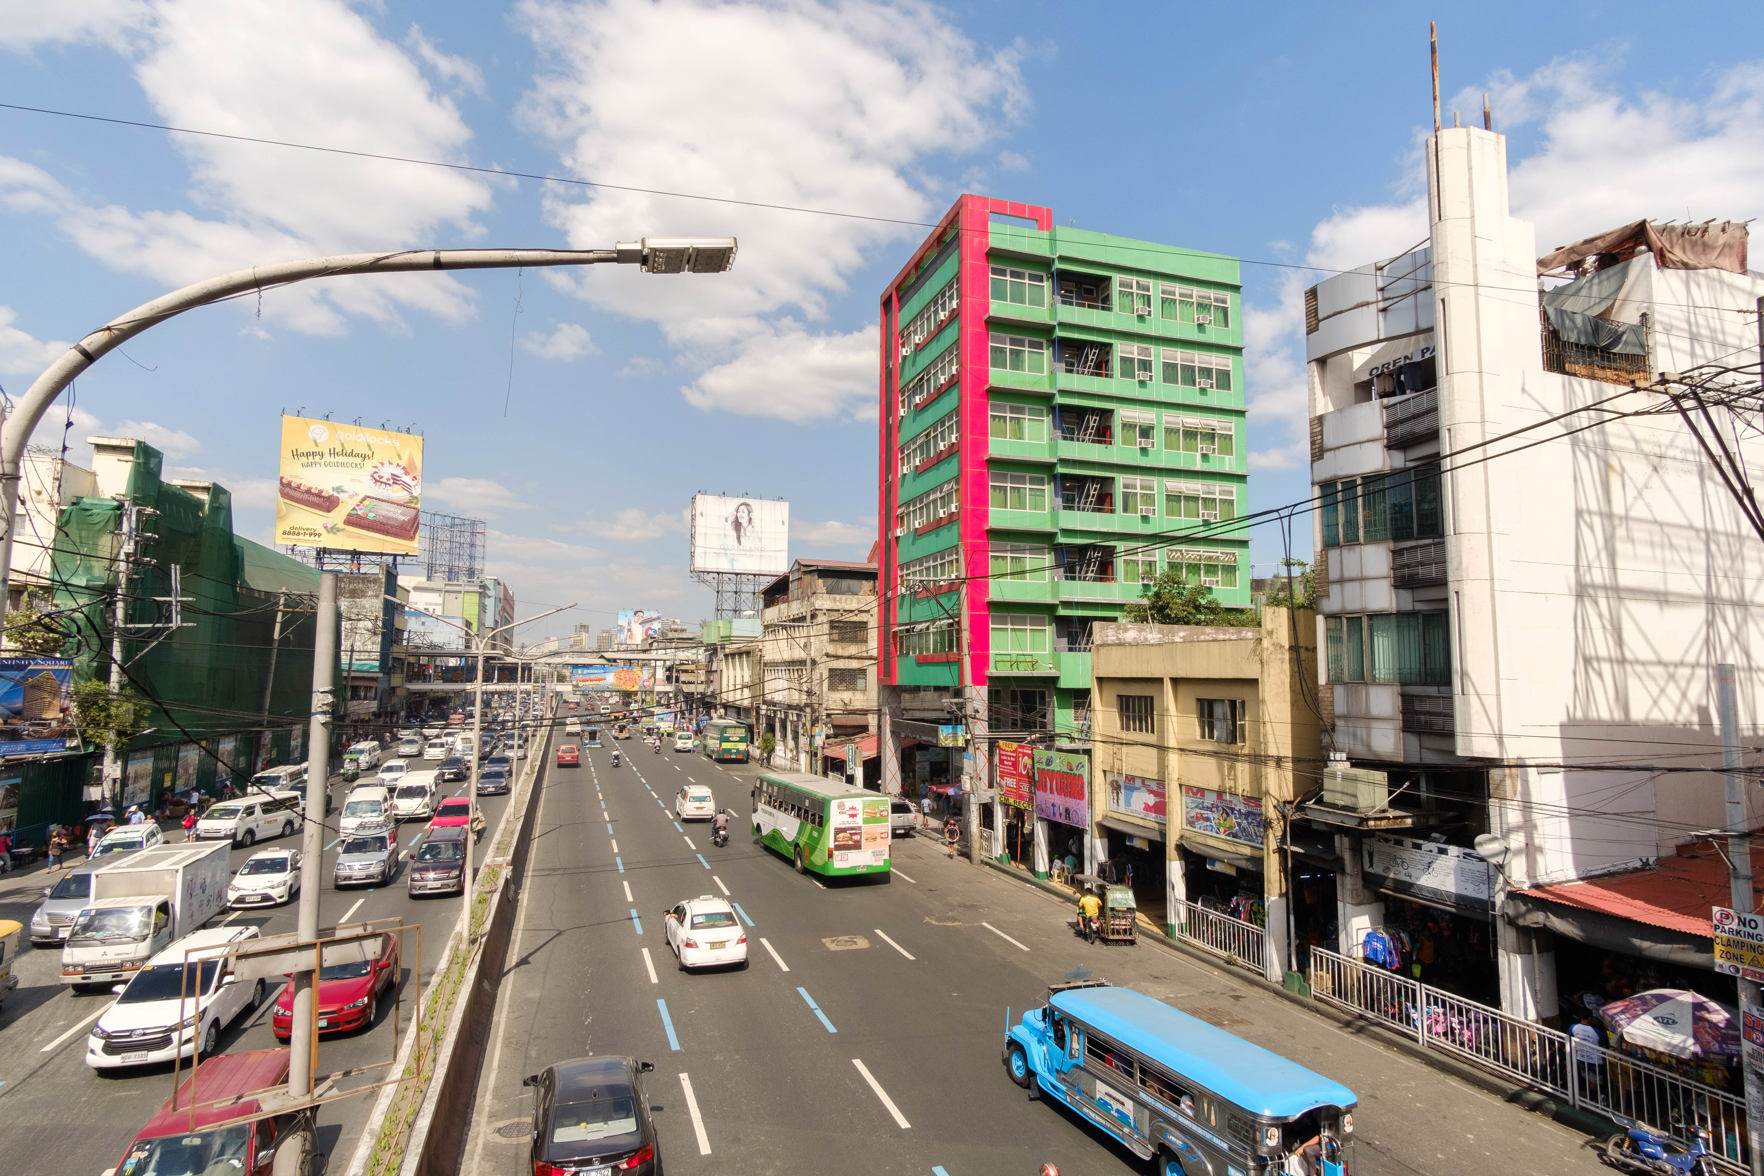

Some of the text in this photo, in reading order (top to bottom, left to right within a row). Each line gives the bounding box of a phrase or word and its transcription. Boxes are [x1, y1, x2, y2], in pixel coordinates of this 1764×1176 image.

[336, 431, 399, 447] goldilocks
[291, 447, 375, 462] Happy Holidays!
[301, 460, 365, 469] HAPPY GOLDILOCKS!
[289, 525, 317, 533] delivery
[1737, 916, 1758, 930] NO
[1714, 924, 1763, 942] PARKING
[1714, 936, 1764, 955] CLAMPING
[1719, 949, 1745, 964] ZONE
